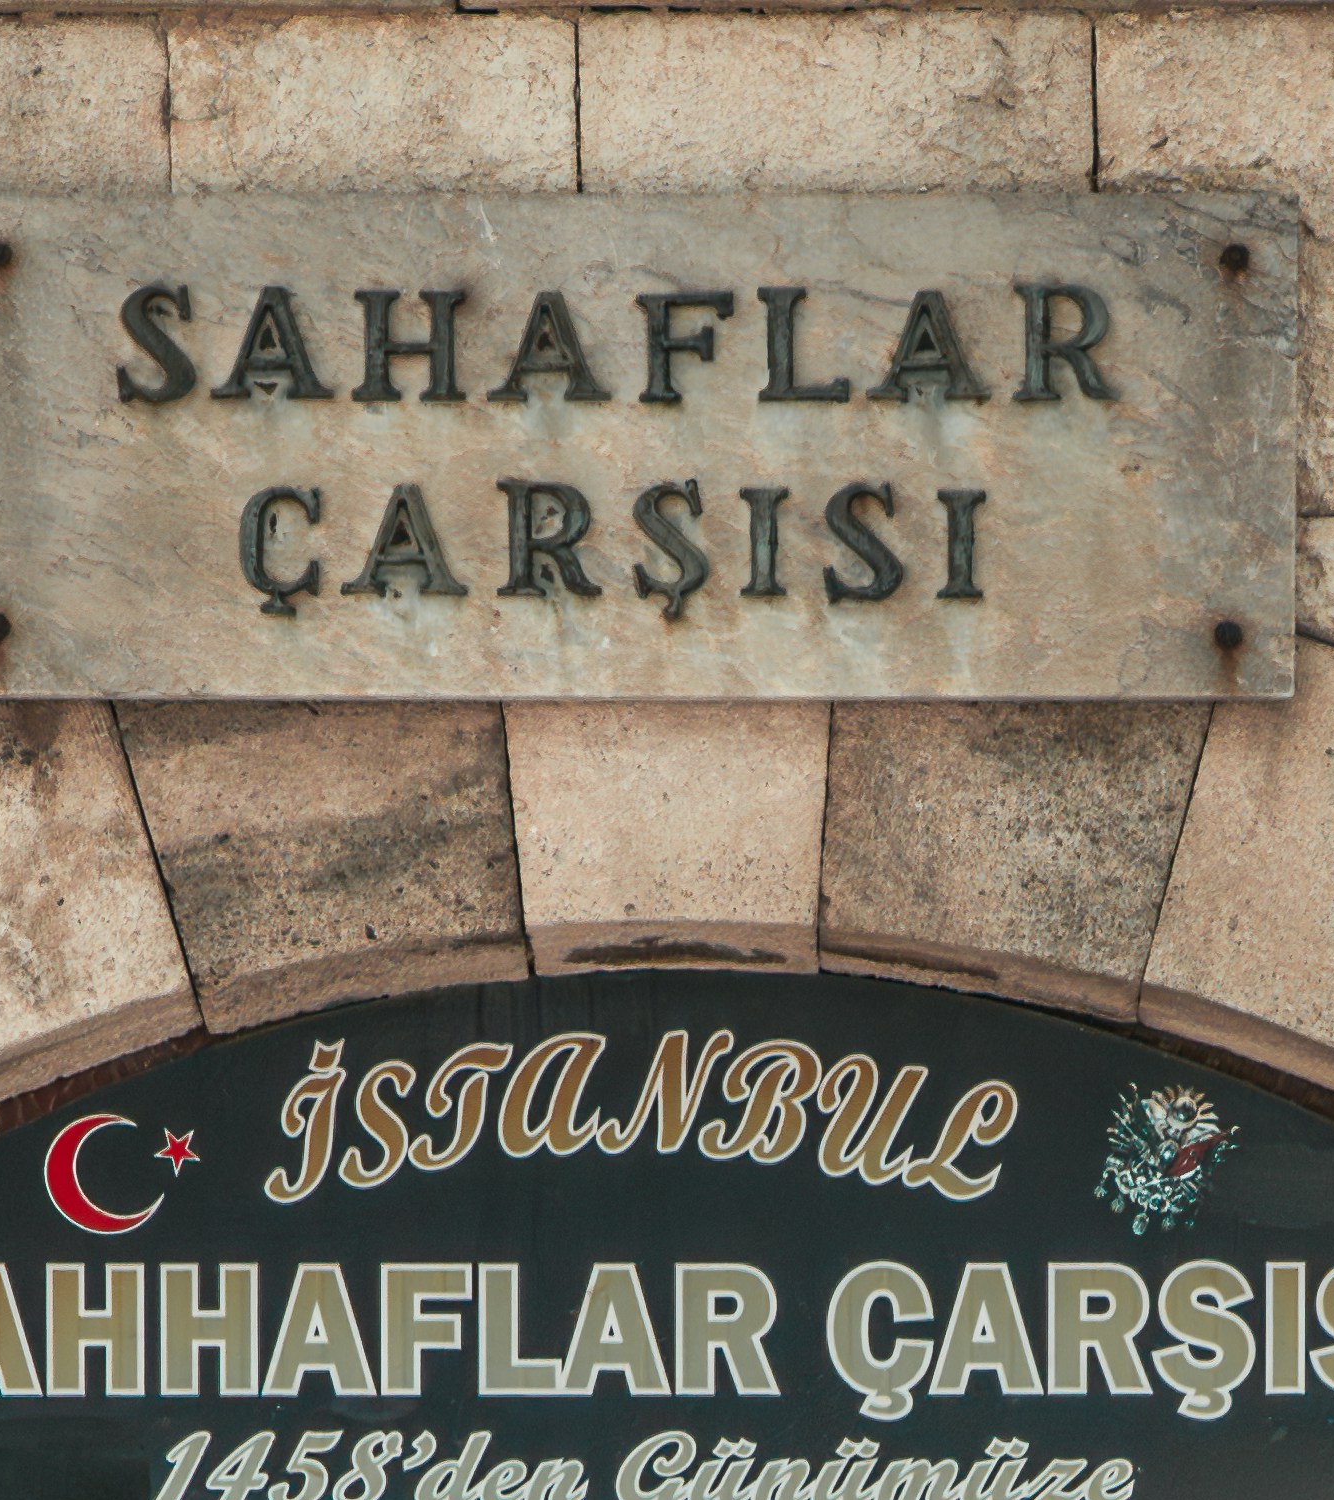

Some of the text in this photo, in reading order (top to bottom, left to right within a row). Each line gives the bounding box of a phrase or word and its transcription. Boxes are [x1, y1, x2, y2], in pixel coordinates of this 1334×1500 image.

[116, 284, 1112, 403] SAHAFLAR
[238, 477, 987, 622] ÇARŞISI
[264, 1028, 1018, 1204] İSTANBUL
